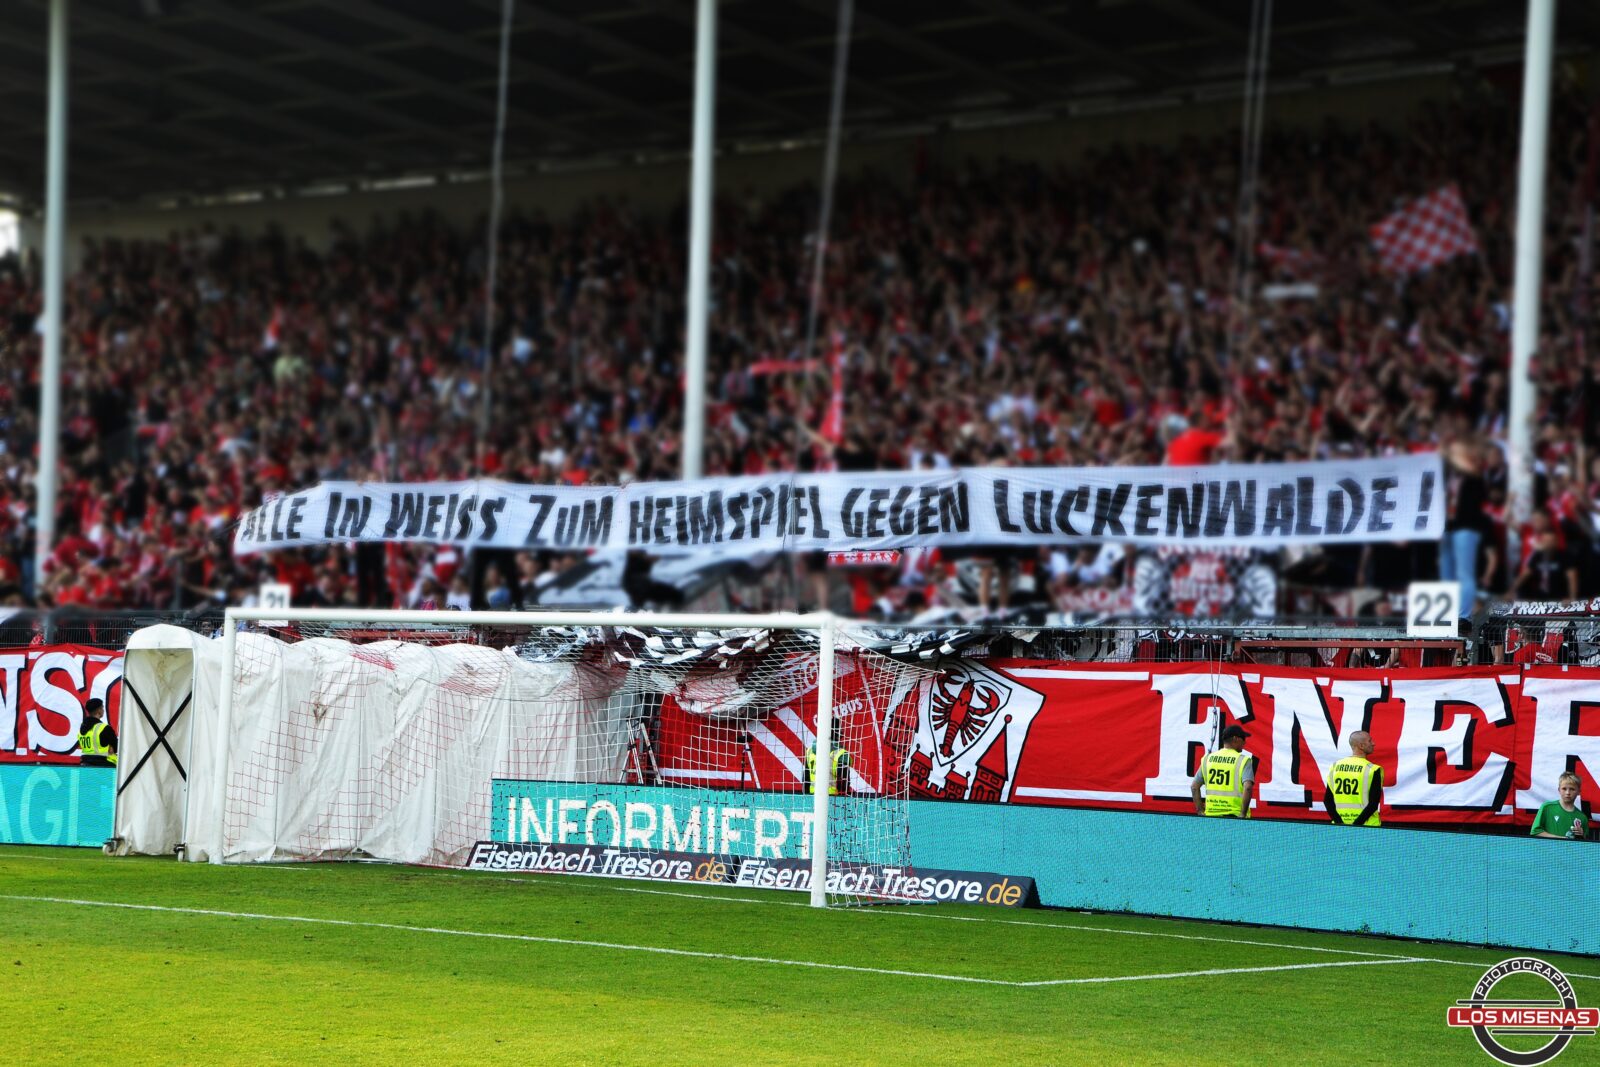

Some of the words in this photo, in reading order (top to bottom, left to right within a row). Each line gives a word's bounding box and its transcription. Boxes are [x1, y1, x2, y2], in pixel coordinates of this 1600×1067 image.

[241, 496, 308, 542] ALLE
[325, 491, 373, 539] IN
[384, 492, 507, 541] WEISS
[628, 484, 830, 546] HEIMSPIEL
[840, 481, 971, 539] GEGEN
[1413, 590, 1452, 626] 22
[1208, 755, 1236, 764] ORDNER
[1335, 763, 1363, 773] ORDNER
[1208, 768, 1231, 786] 251
[1335, 778, 1359, 795] 262
[469, 843, 596, 872] Eisenbach
[598, 848, 728, 882] Tresore.de
[736, 859, 876, 891] Eisenach
[881, 868, 1023, 906] Tresore.de
